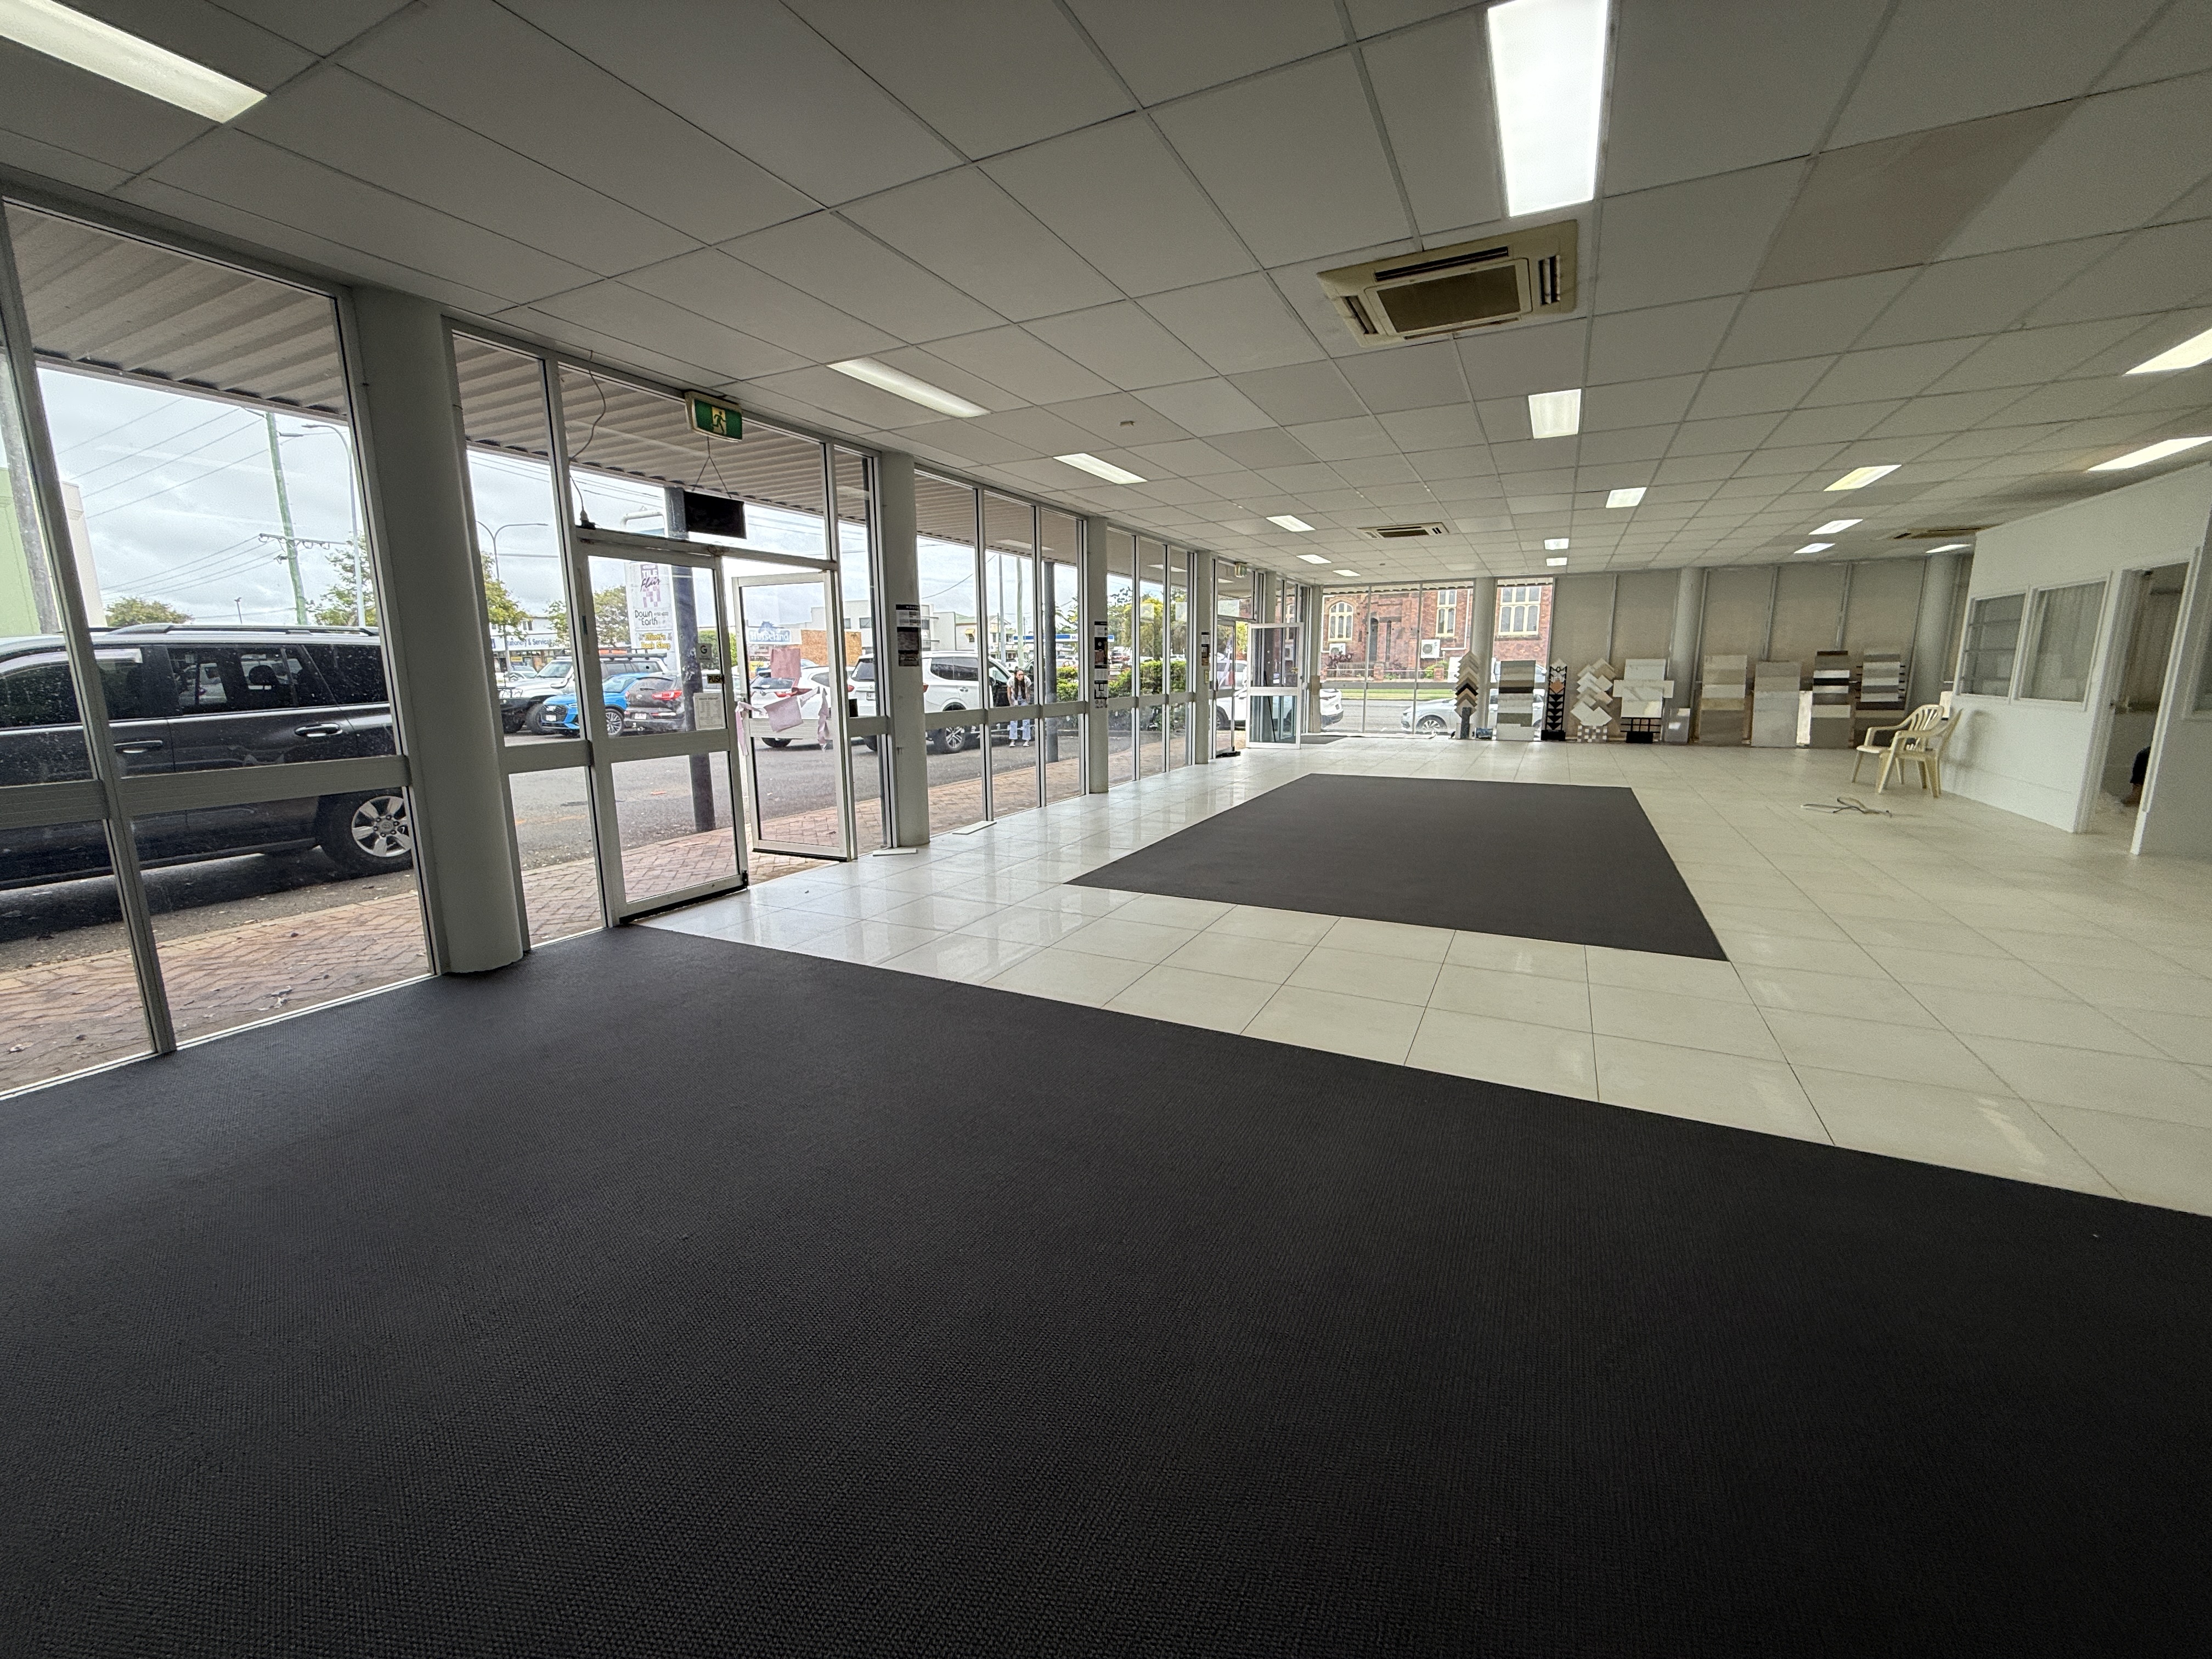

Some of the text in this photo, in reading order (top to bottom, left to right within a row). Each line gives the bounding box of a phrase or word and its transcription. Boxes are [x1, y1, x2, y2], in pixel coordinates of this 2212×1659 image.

[642, 569, 658, 578] TILE
[640, 577, 661, 592] Flair
[644, 633, 667, 641] Elliott's
[749, 631, 788, 641] Horseland
[700, 645, 708, 654] G
[708, 675, 725, 684] PUSH
